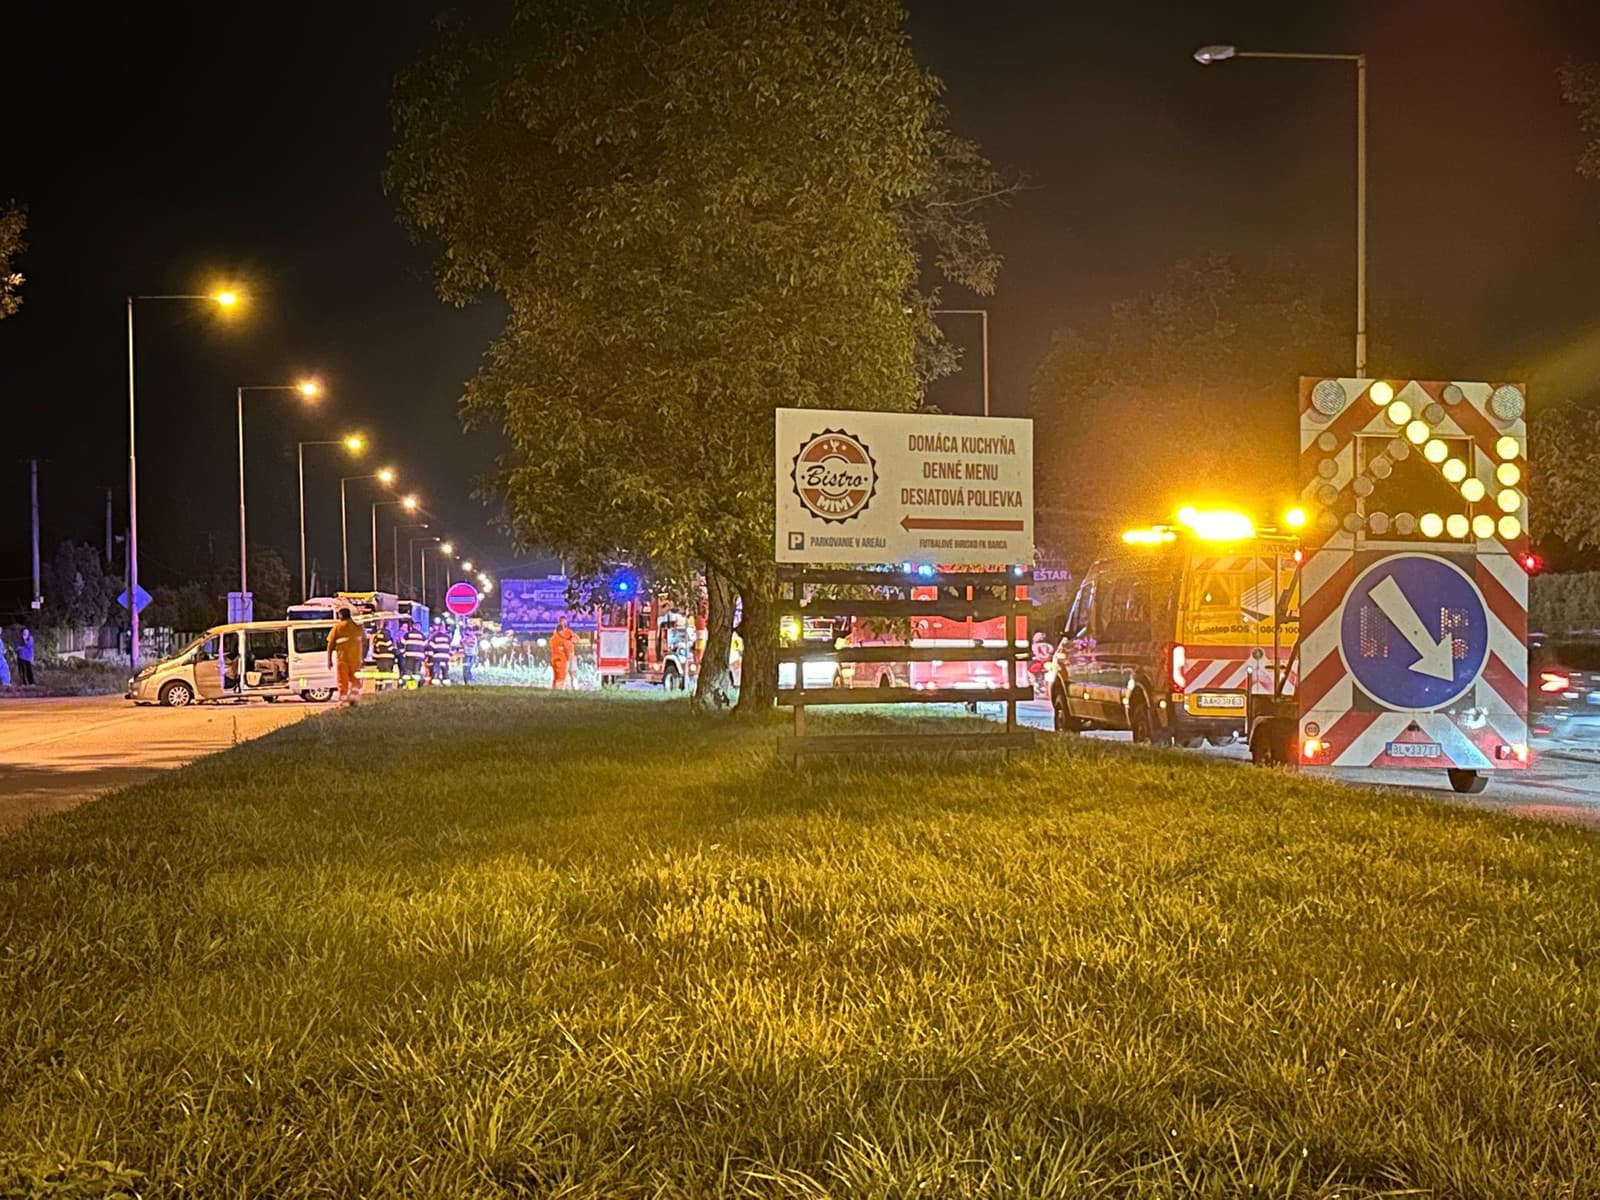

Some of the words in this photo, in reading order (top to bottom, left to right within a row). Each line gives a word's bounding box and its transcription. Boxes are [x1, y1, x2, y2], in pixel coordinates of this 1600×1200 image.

[908, 432, 958, 453] DOMÁCA
[961, 434, 1016, 455] KUCHYŇA
[806, 465, 862, 487] Bistro
[923, 460, 962, 480] DENNÉ
[965, 463, 999, 481] MENU
[816, 495, 855, 513] MIMI
[901, 486, 965, 506] DESIATOVÁ
[967, 489, 1023, 508] POLIEVKA
[810, 536, 854, 548] PARKOVANIE
[855, 537, 861, 548] V
[1231, 624, 1250, 633] SOS
